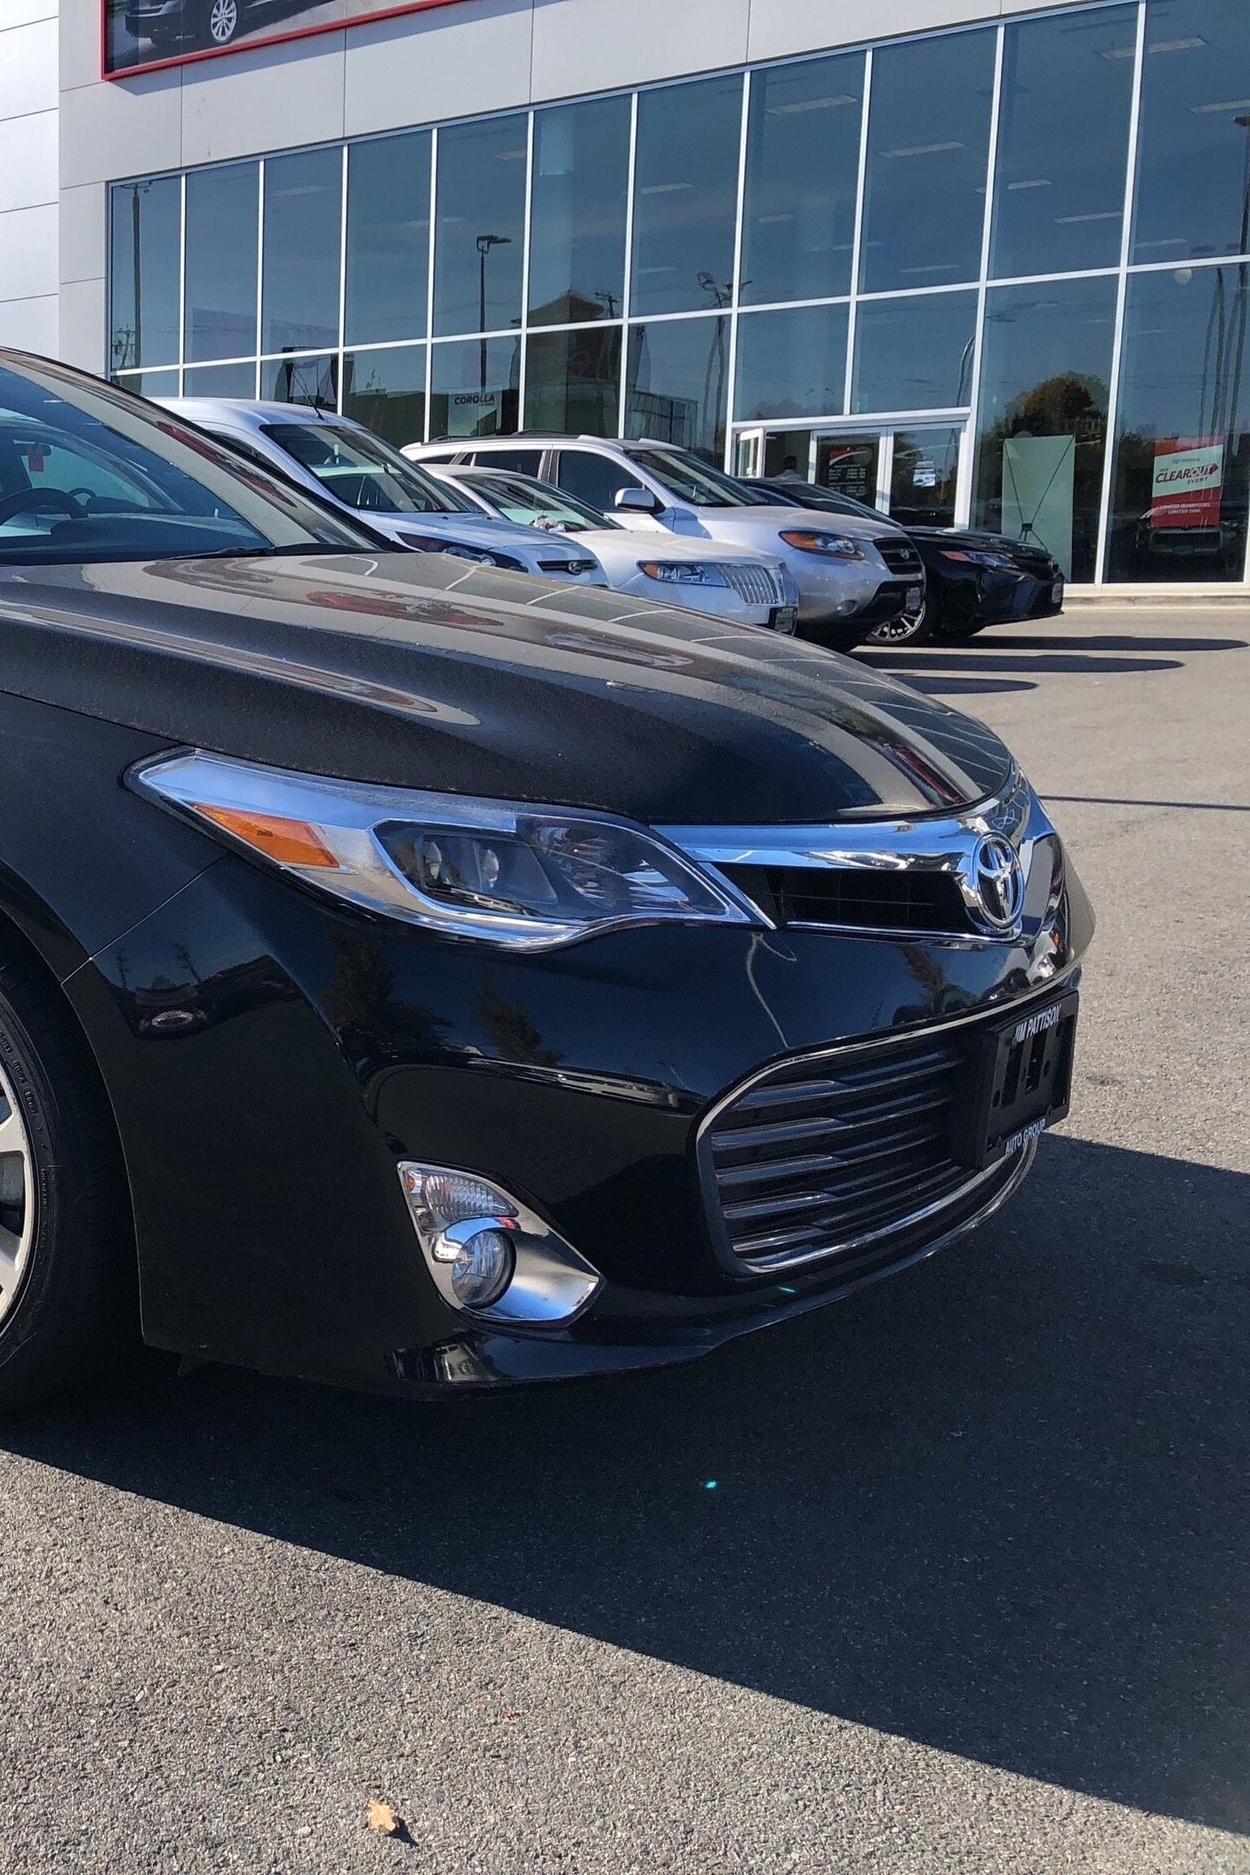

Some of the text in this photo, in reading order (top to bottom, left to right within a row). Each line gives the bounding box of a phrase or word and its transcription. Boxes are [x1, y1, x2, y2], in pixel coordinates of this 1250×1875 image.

[454, 394, 495, 405] COROLLA
[1187, 476, 1209, 485] EVENT
[1013, 1003, 1062, 1044] JIM PATTISON
[1005, 1117, 1046, 1156] AUTO GROUP
